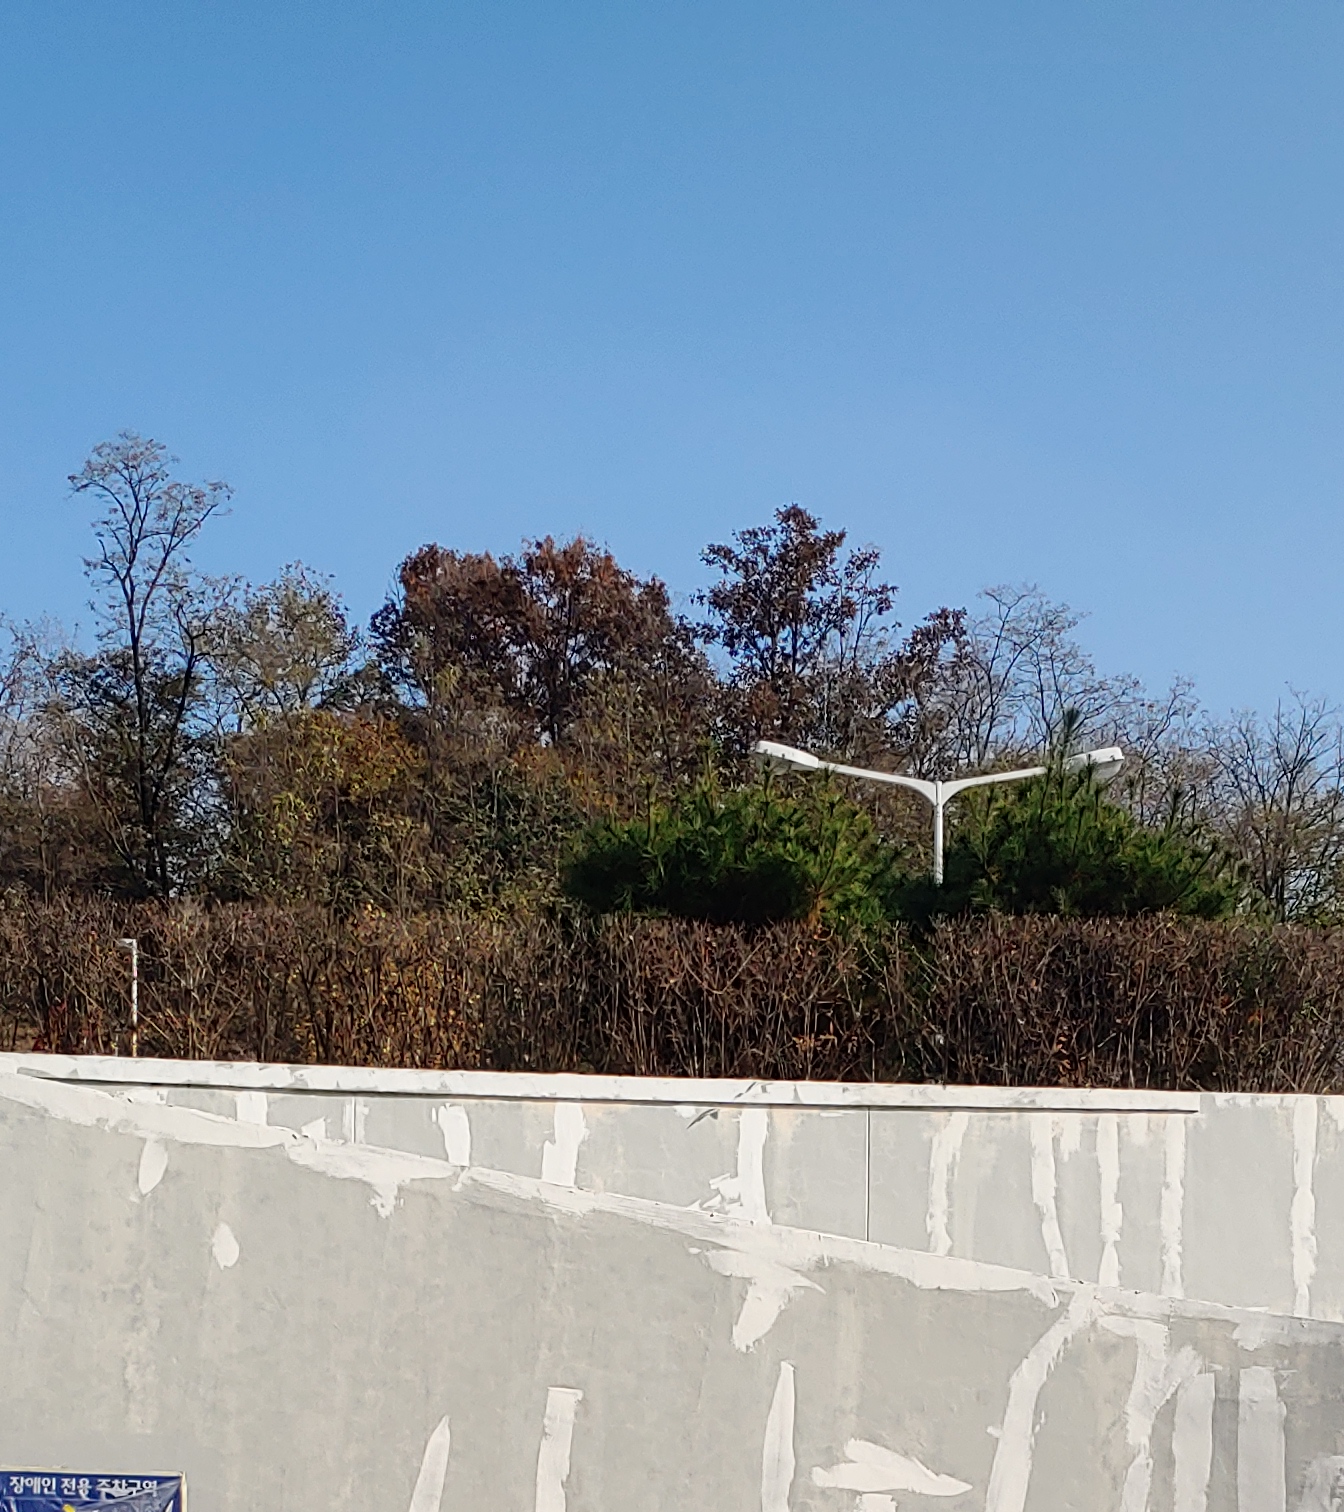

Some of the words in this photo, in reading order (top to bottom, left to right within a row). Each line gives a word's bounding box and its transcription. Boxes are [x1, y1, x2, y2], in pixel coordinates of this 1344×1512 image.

[9, 1476, 56, 1495] 장애인
[61, 1478, 92, 1496] 전용
[97, 1480, 157, 1498] 주차구역
